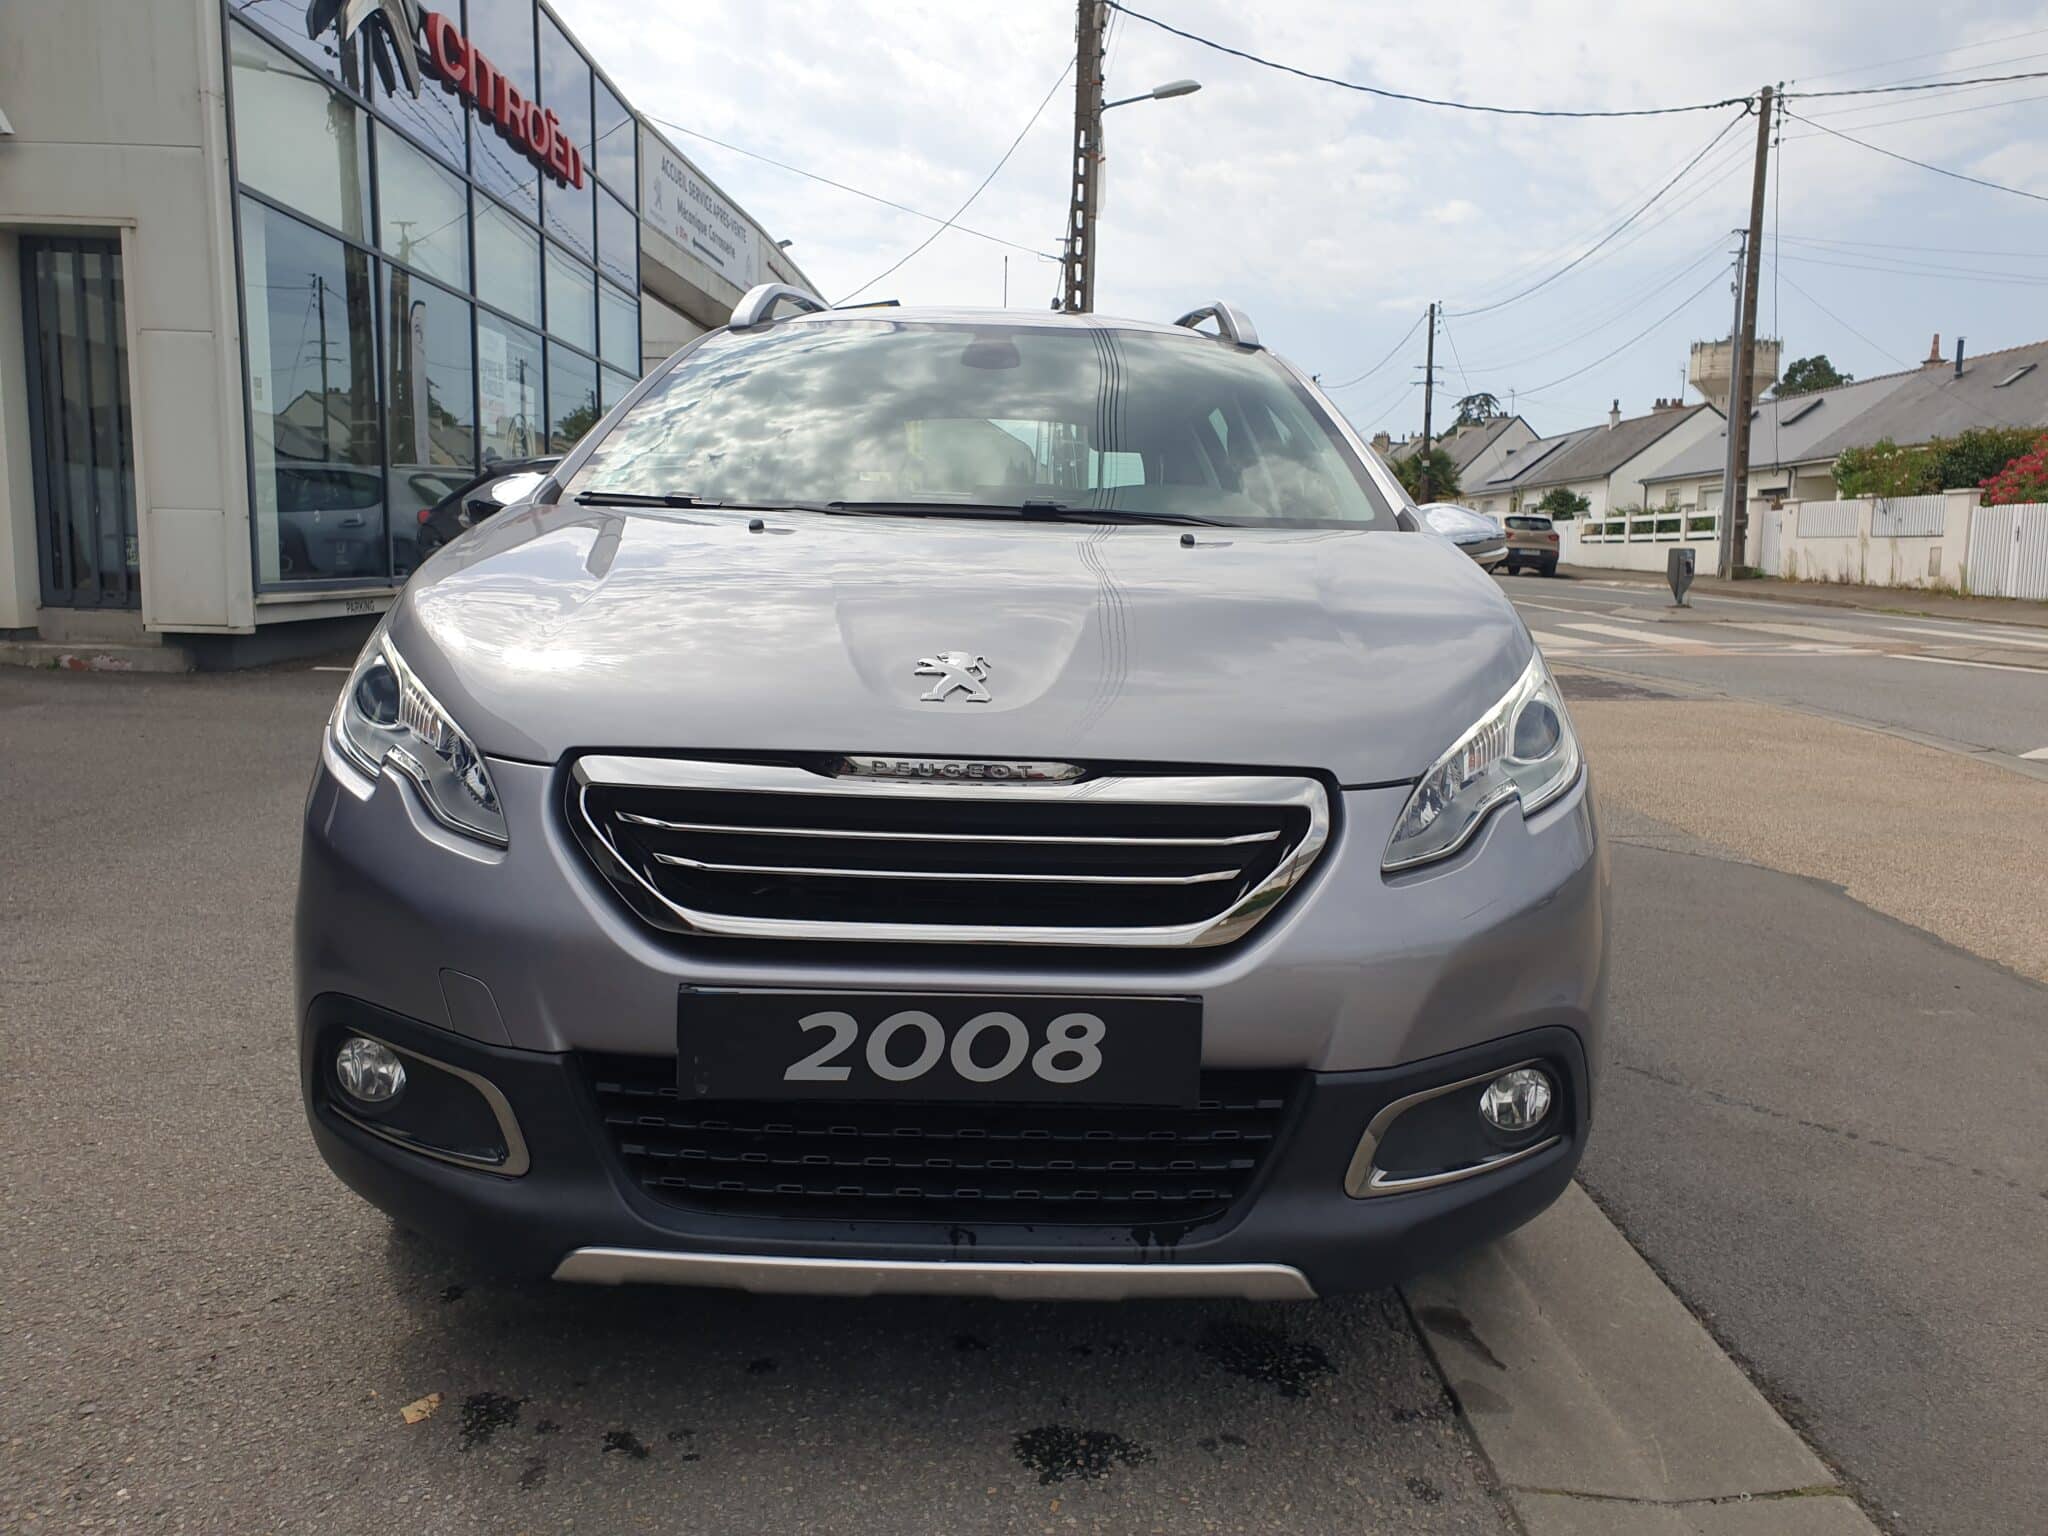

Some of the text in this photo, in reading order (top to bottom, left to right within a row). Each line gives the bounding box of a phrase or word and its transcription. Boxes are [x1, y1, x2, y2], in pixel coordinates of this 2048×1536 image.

[661, 155, 688, 193] ACCUEIL
[688, 179, 713, 215] SERVICE
[345, 599, 375, 614] PARKING
[871, 760, 1033, 778] PEUGEOT
[783, 1010, 1107, 1084] 2008
